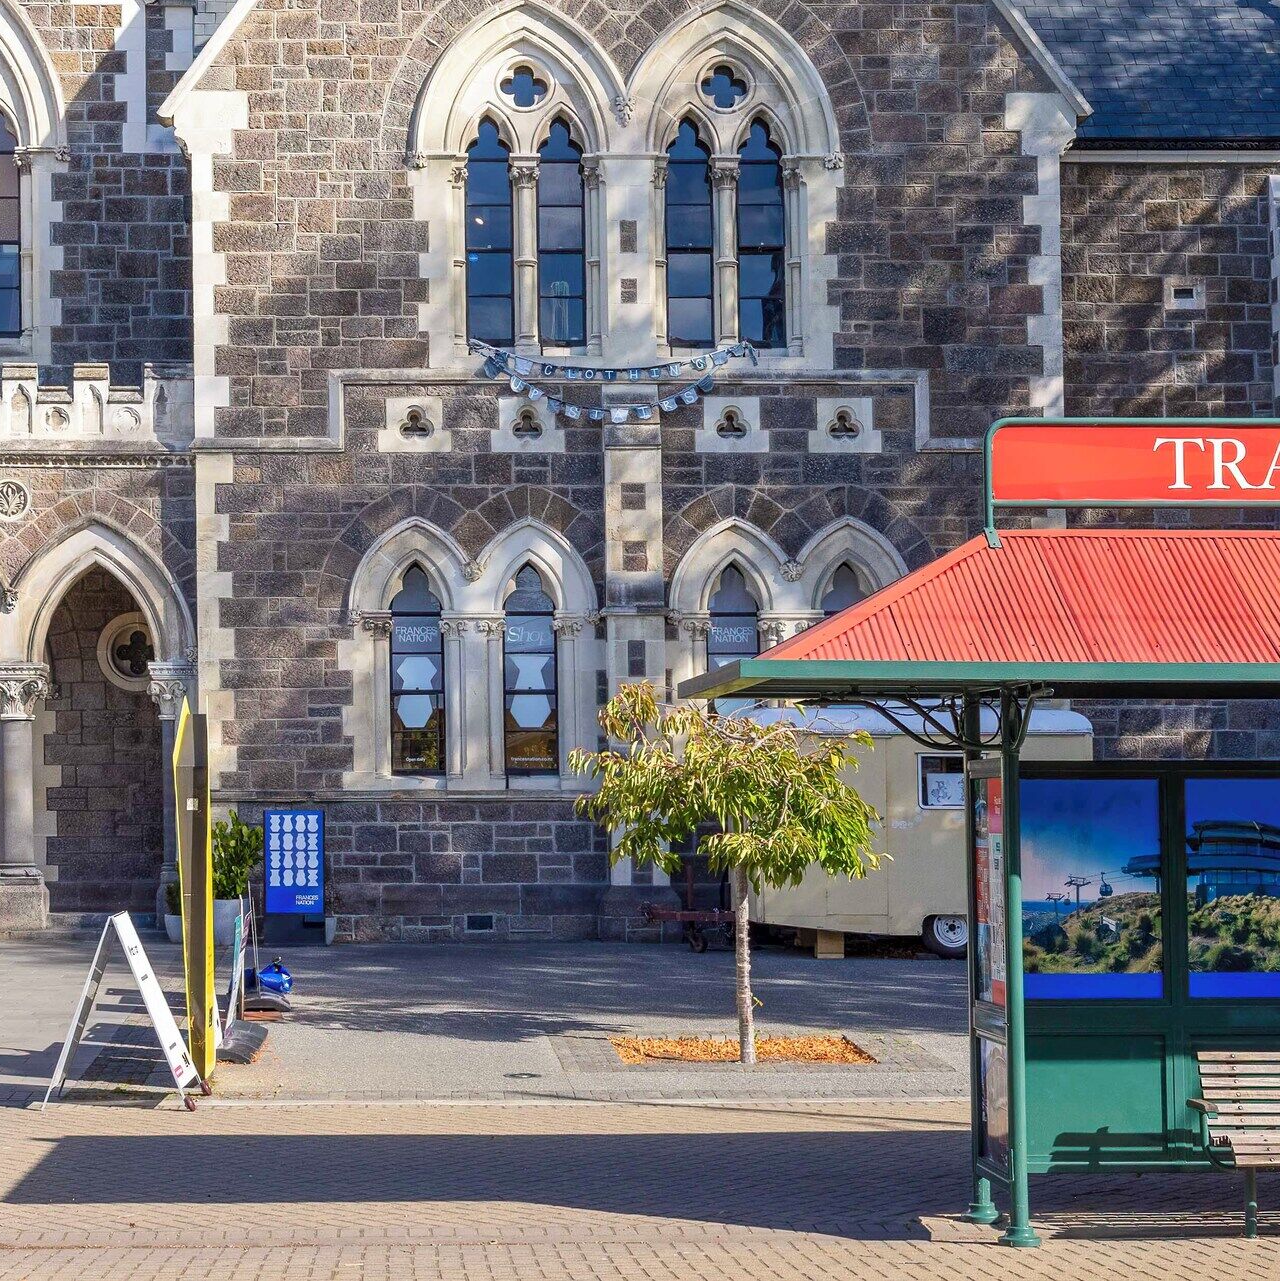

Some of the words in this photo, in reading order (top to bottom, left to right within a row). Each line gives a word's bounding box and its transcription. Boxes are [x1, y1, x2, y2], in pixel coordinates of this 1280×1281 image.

[543, 358, 706, 380] CLOTHING
[510, 376, 541, 398] UP
[569, 391, 697, 422] STAIRS
[395, 626, 438, 635] FRANCES
[712, 626, 754, 635] FRANCES
[399, 634, 432, 642] NATION
[507, 626, 550, 645] Shop
[715, 634, 749, 643] NATION
